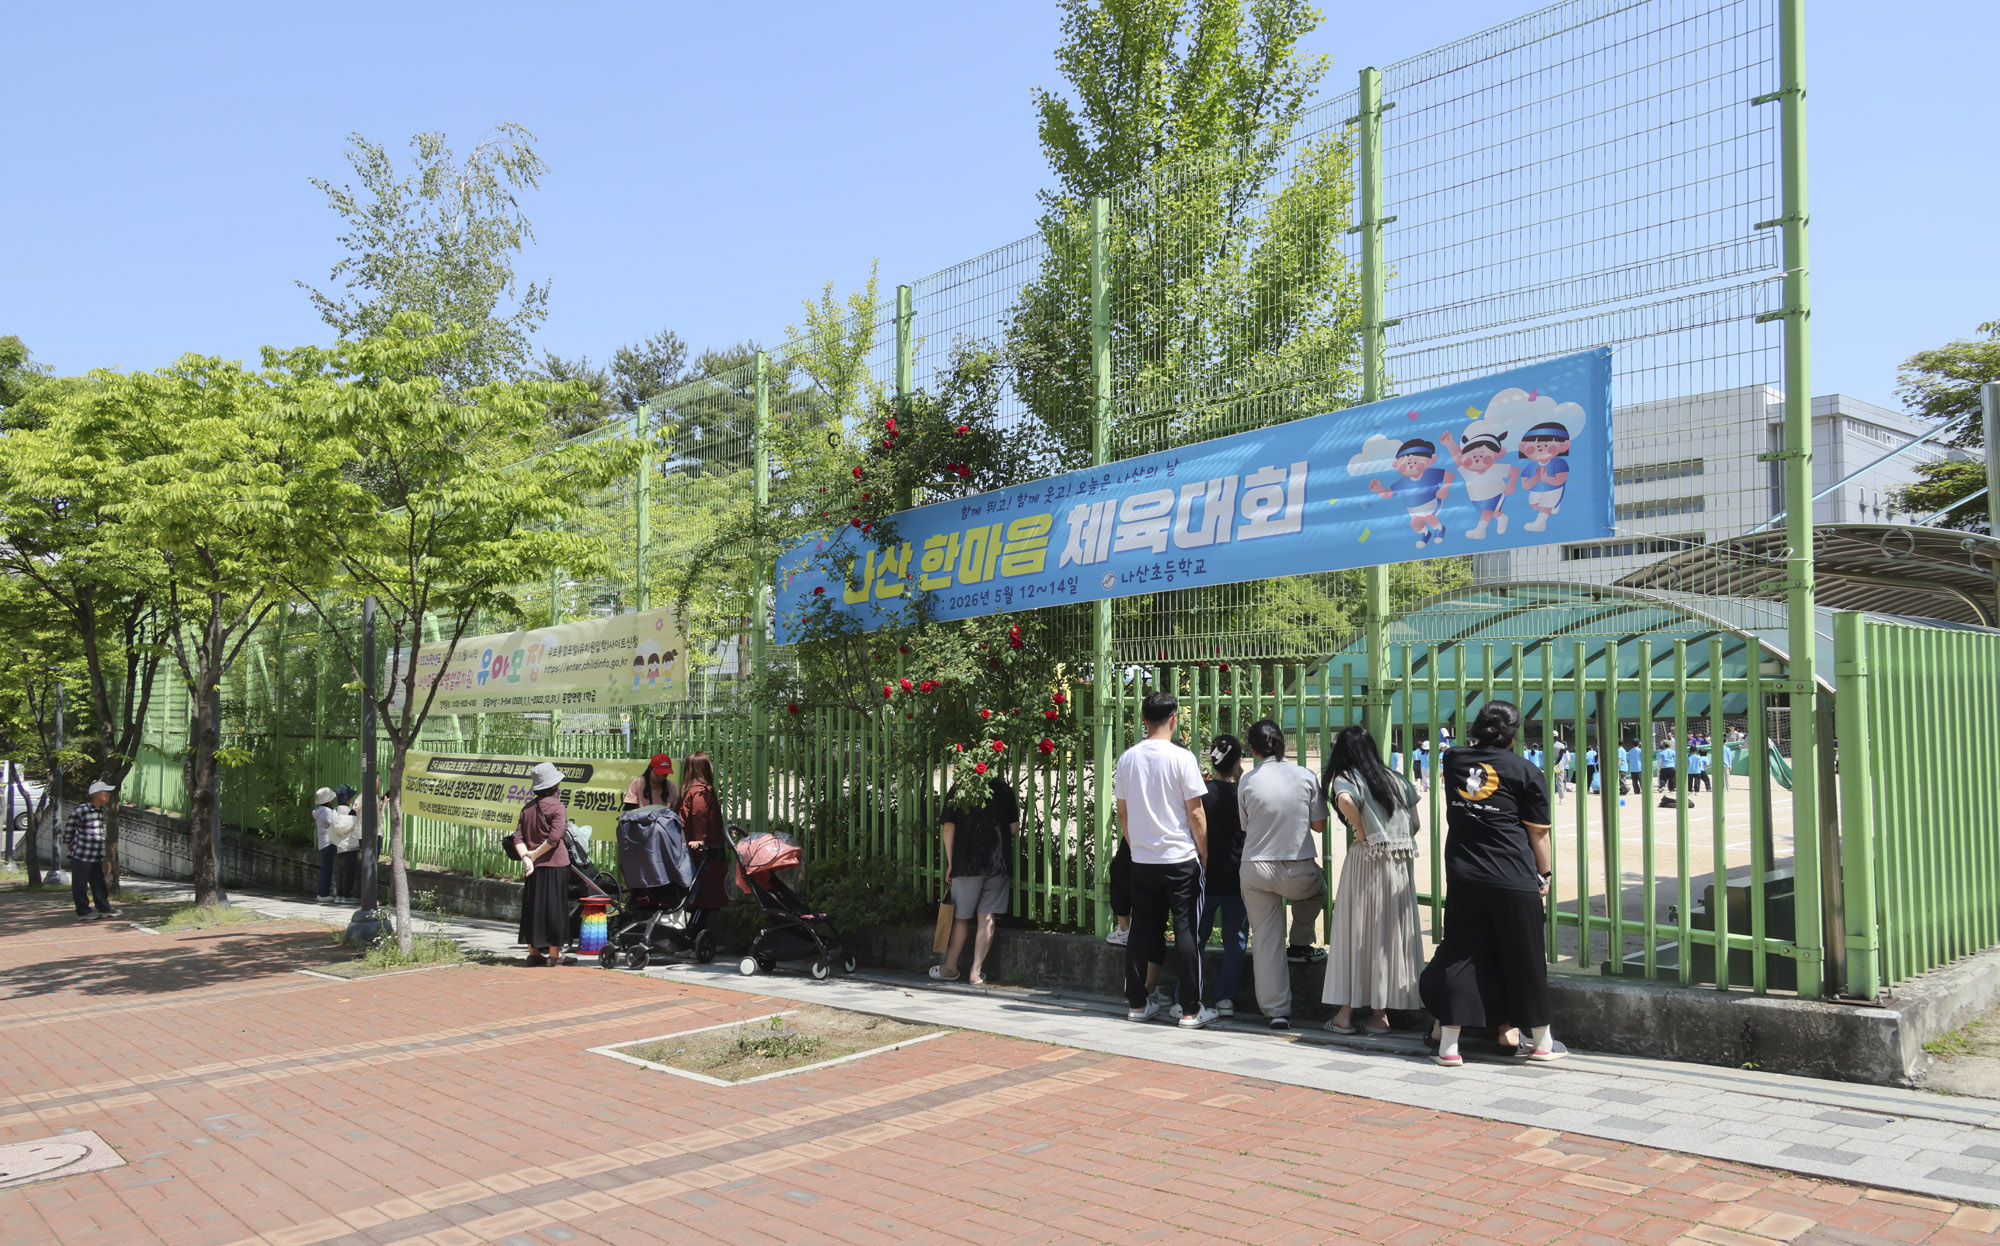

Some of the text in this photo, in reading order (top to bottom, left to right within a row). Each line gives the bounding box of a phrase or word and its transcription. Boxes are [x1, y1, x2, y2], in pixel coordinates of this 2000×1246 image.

[961, 458, 1180, 520] 함께 뛰고! 함께 웃고! 오늘은 나산의 날
[843, 461, 1308, 604] 나산 한마음 체육대회
[1121, 558, 1207, 584] 나산초등학교
[949, 589, 990, 609] 2026년
[995, 585, 1013, 605] 5월
[1020, 576, 1079, 600] 12~14일
[477, 643, 546, 686] 유아모집
[573, 790, 626, 812] 축하합니
